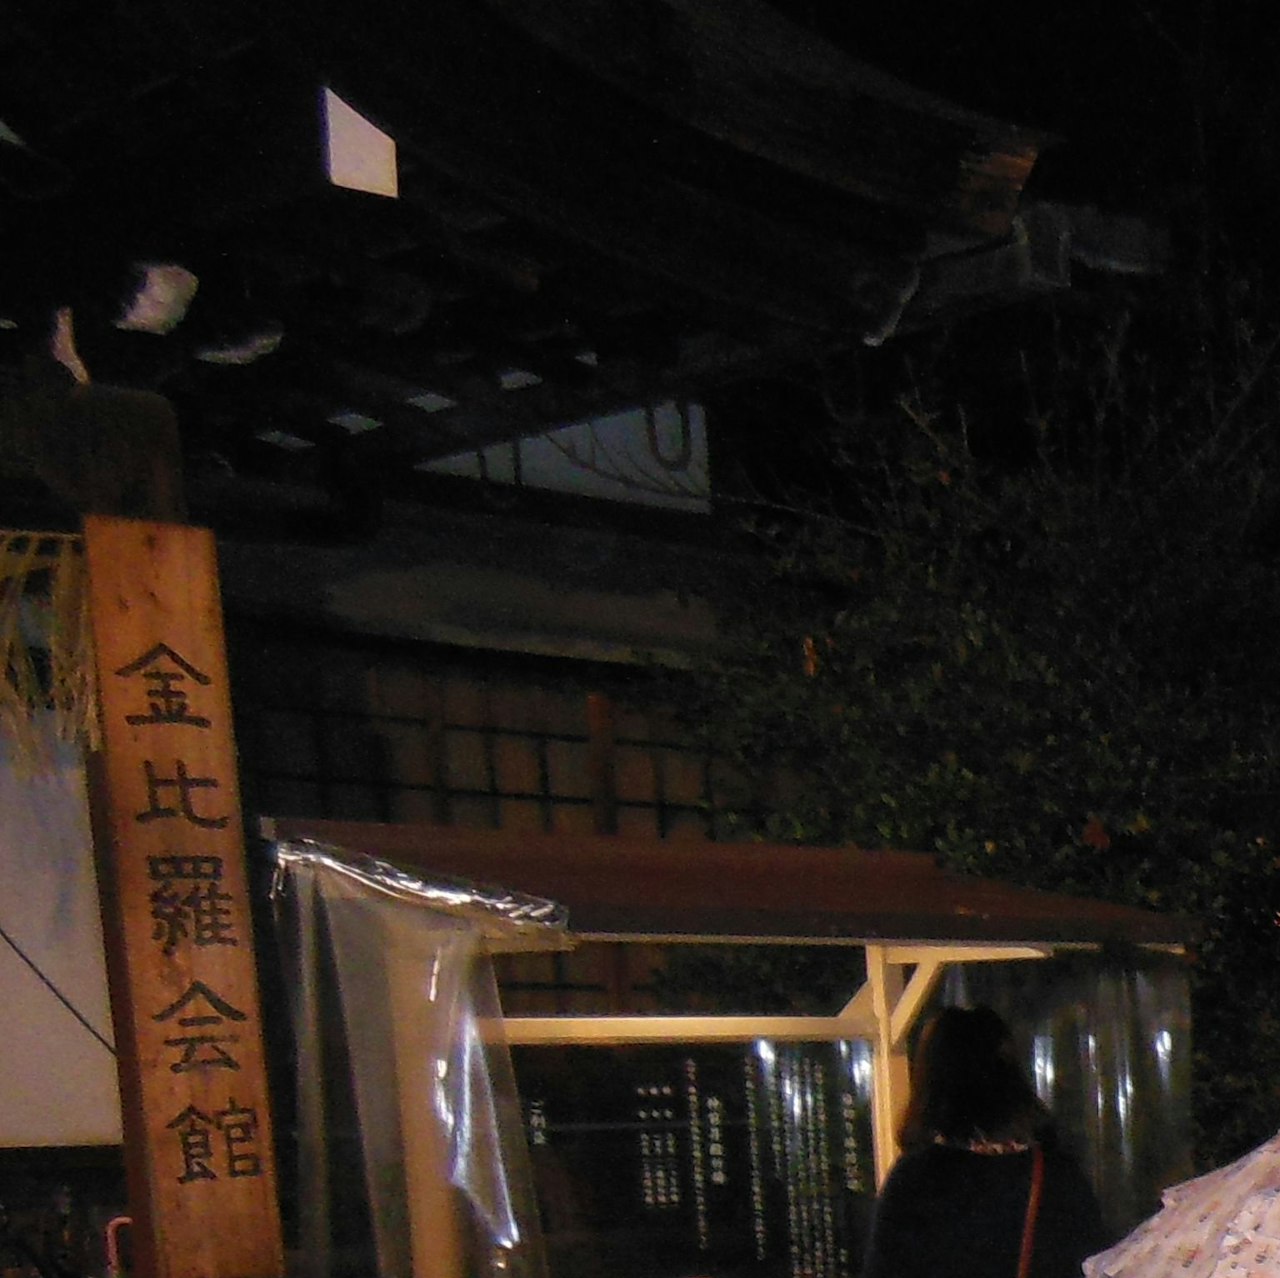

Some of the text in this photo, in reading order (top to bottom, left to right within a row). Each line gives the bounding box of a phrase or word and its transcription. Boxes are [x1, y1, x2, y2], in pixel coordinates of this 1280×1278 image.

[115, 640, 260, 1184] 金比羅会館
